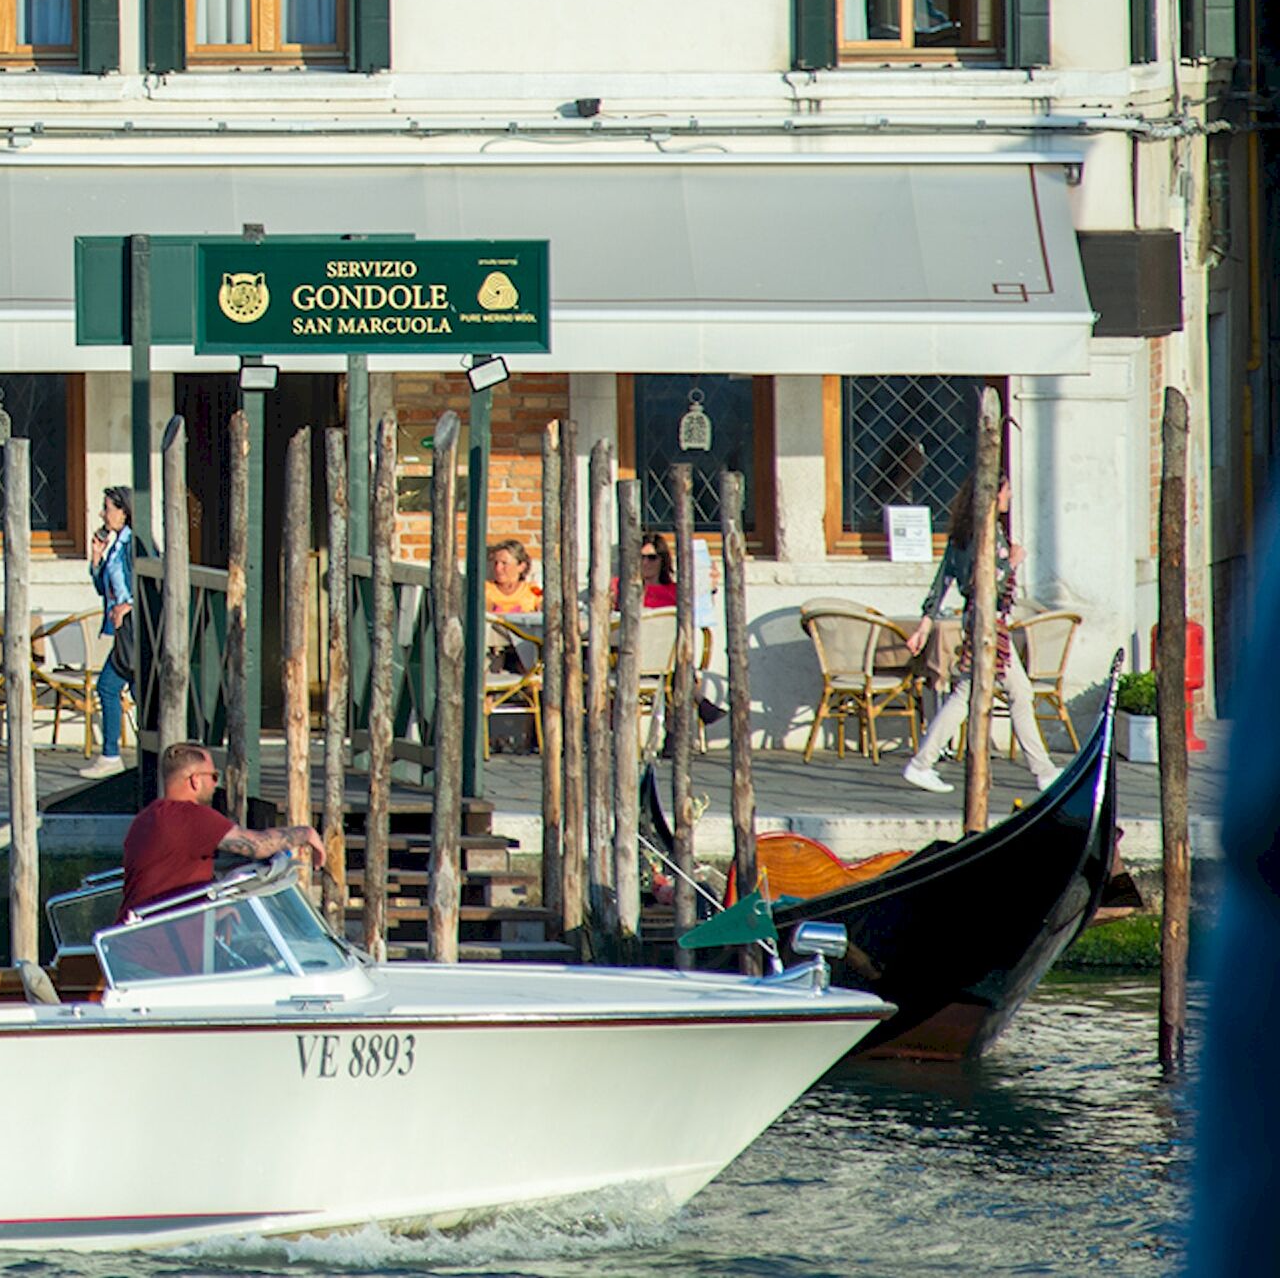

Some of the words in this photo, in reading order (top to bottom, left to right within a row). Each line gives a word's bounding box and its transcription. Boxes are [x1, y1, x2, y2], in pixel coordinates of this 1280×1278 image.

[326, 260, 418, 278] SERVIZIO
[291, 284, 449, 311] GONDOLE
[292, 317, 333, 335] SAN
[337, 316, 452, 335] MARCUOLA
[296, 1034, 340, 1078] VE
[348, 1034, 416, 1078] 8893
